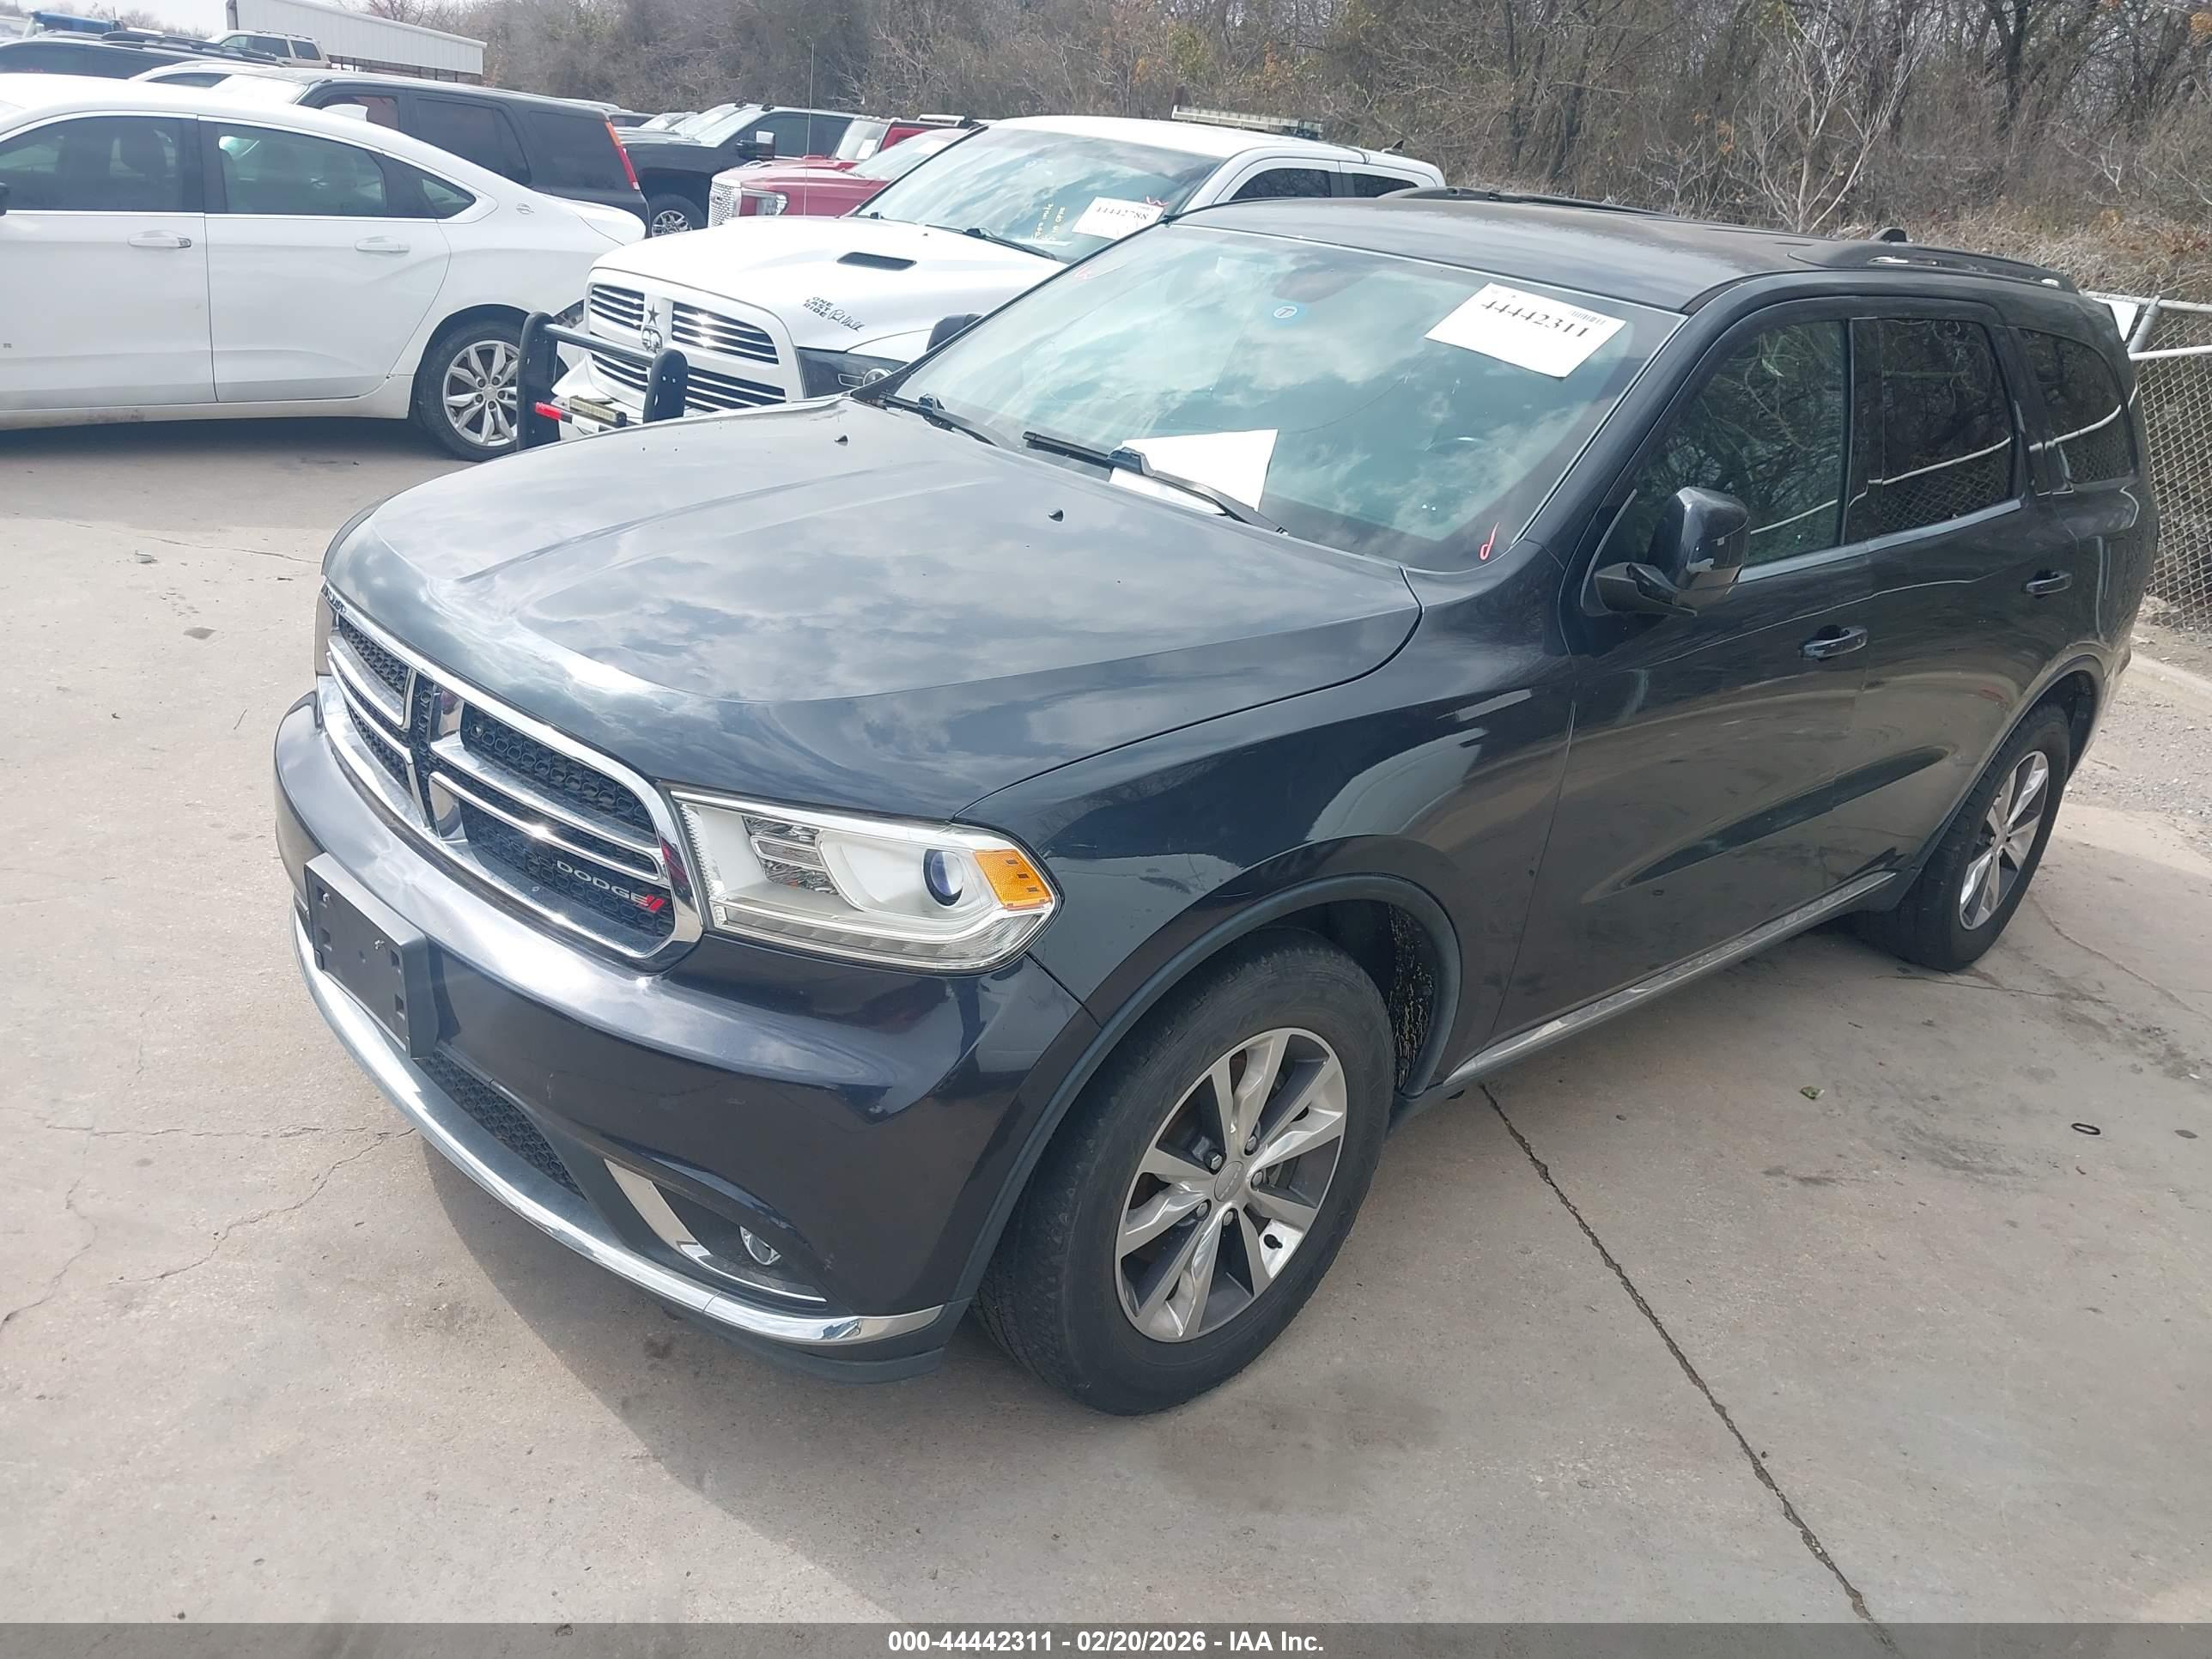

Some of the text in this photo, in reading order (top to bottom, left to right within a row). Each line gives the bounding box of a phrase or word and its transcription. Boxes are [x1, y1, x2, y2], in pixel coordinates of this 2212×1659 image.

[805, 298, 831, 312] LAST
[812, 296, 835, 307] ONE
[802, 302, 828, 318] RIDE
[1480, 300, 1590, 337] 44442311
[556, 860, 649, 907] DODGE
